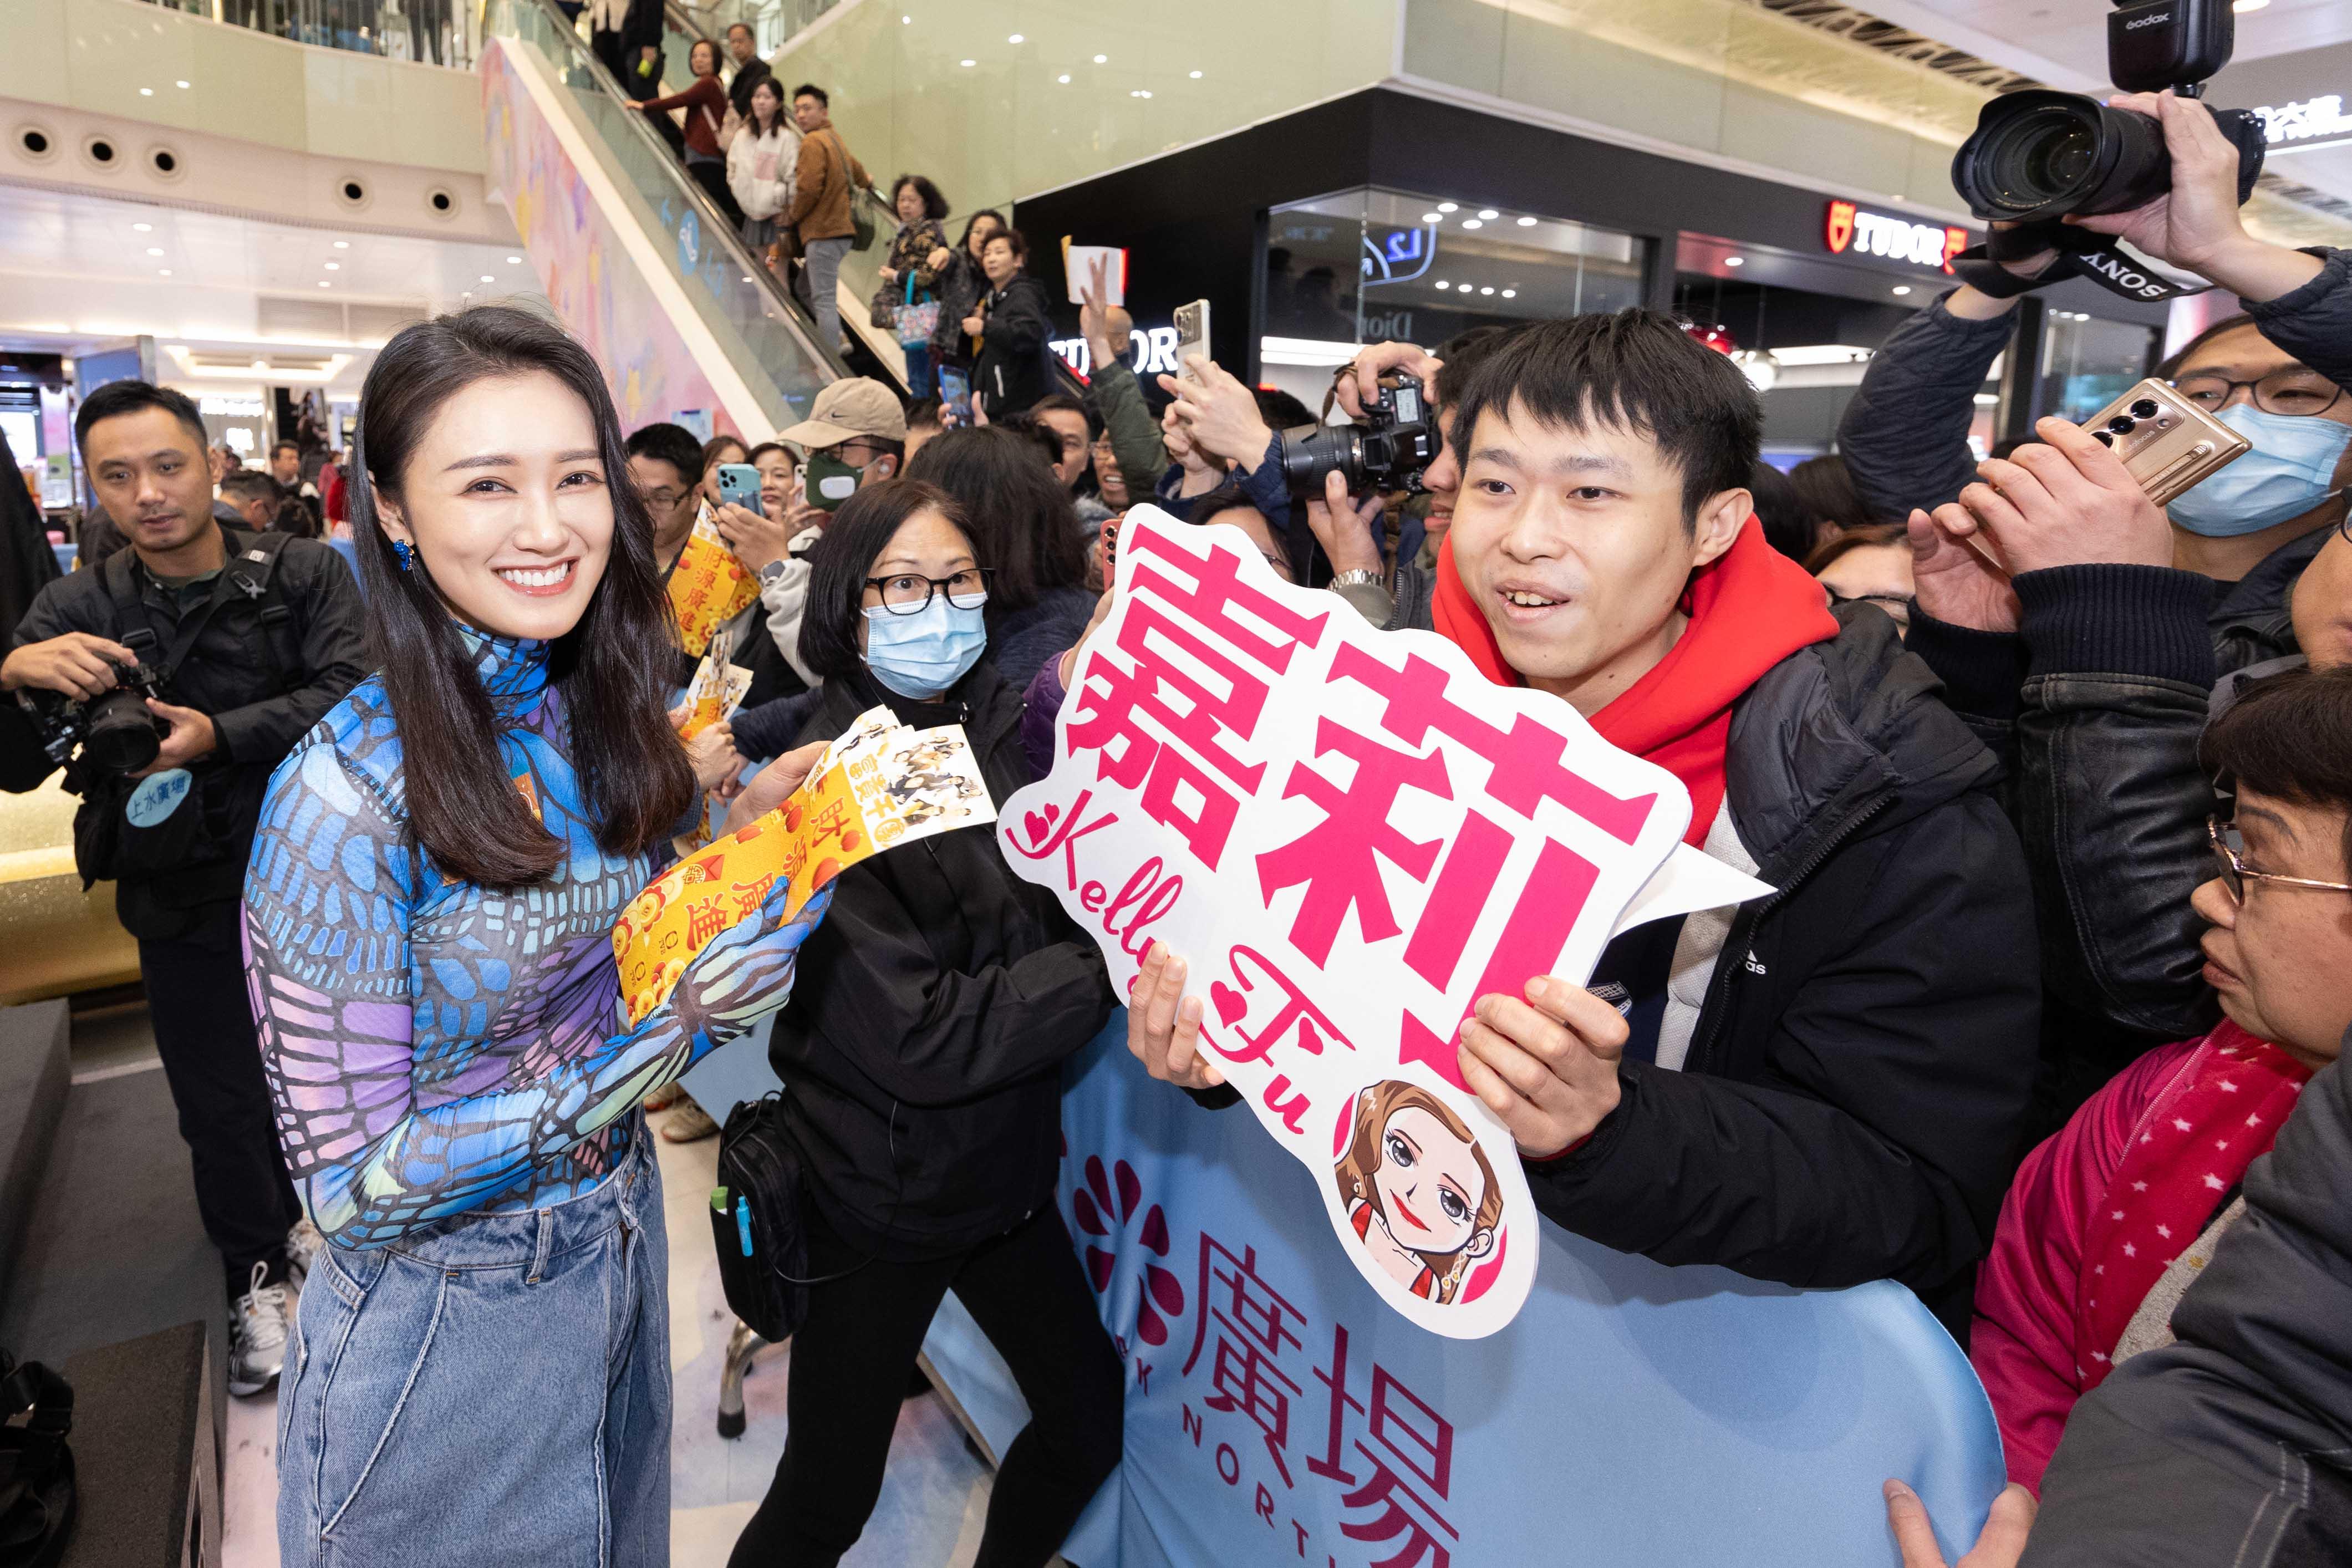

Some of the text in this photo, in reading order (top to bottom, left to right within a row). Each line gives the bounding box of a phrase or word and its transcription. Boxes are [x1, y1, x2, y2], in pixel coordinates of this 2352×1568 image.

[2125, 13, 2169, 29] Godox
[1854, 212, 1946, 267] TUDOR
[2079, 252, 2168, 297] SONY
[679, 546, 726, 632] 財源廣進
[132, 776, 186, 819] 上水廣場
[1065, 522, 1658, 1096] 嘉莉
[1182, 1230, 1459, 1568] 廣場
